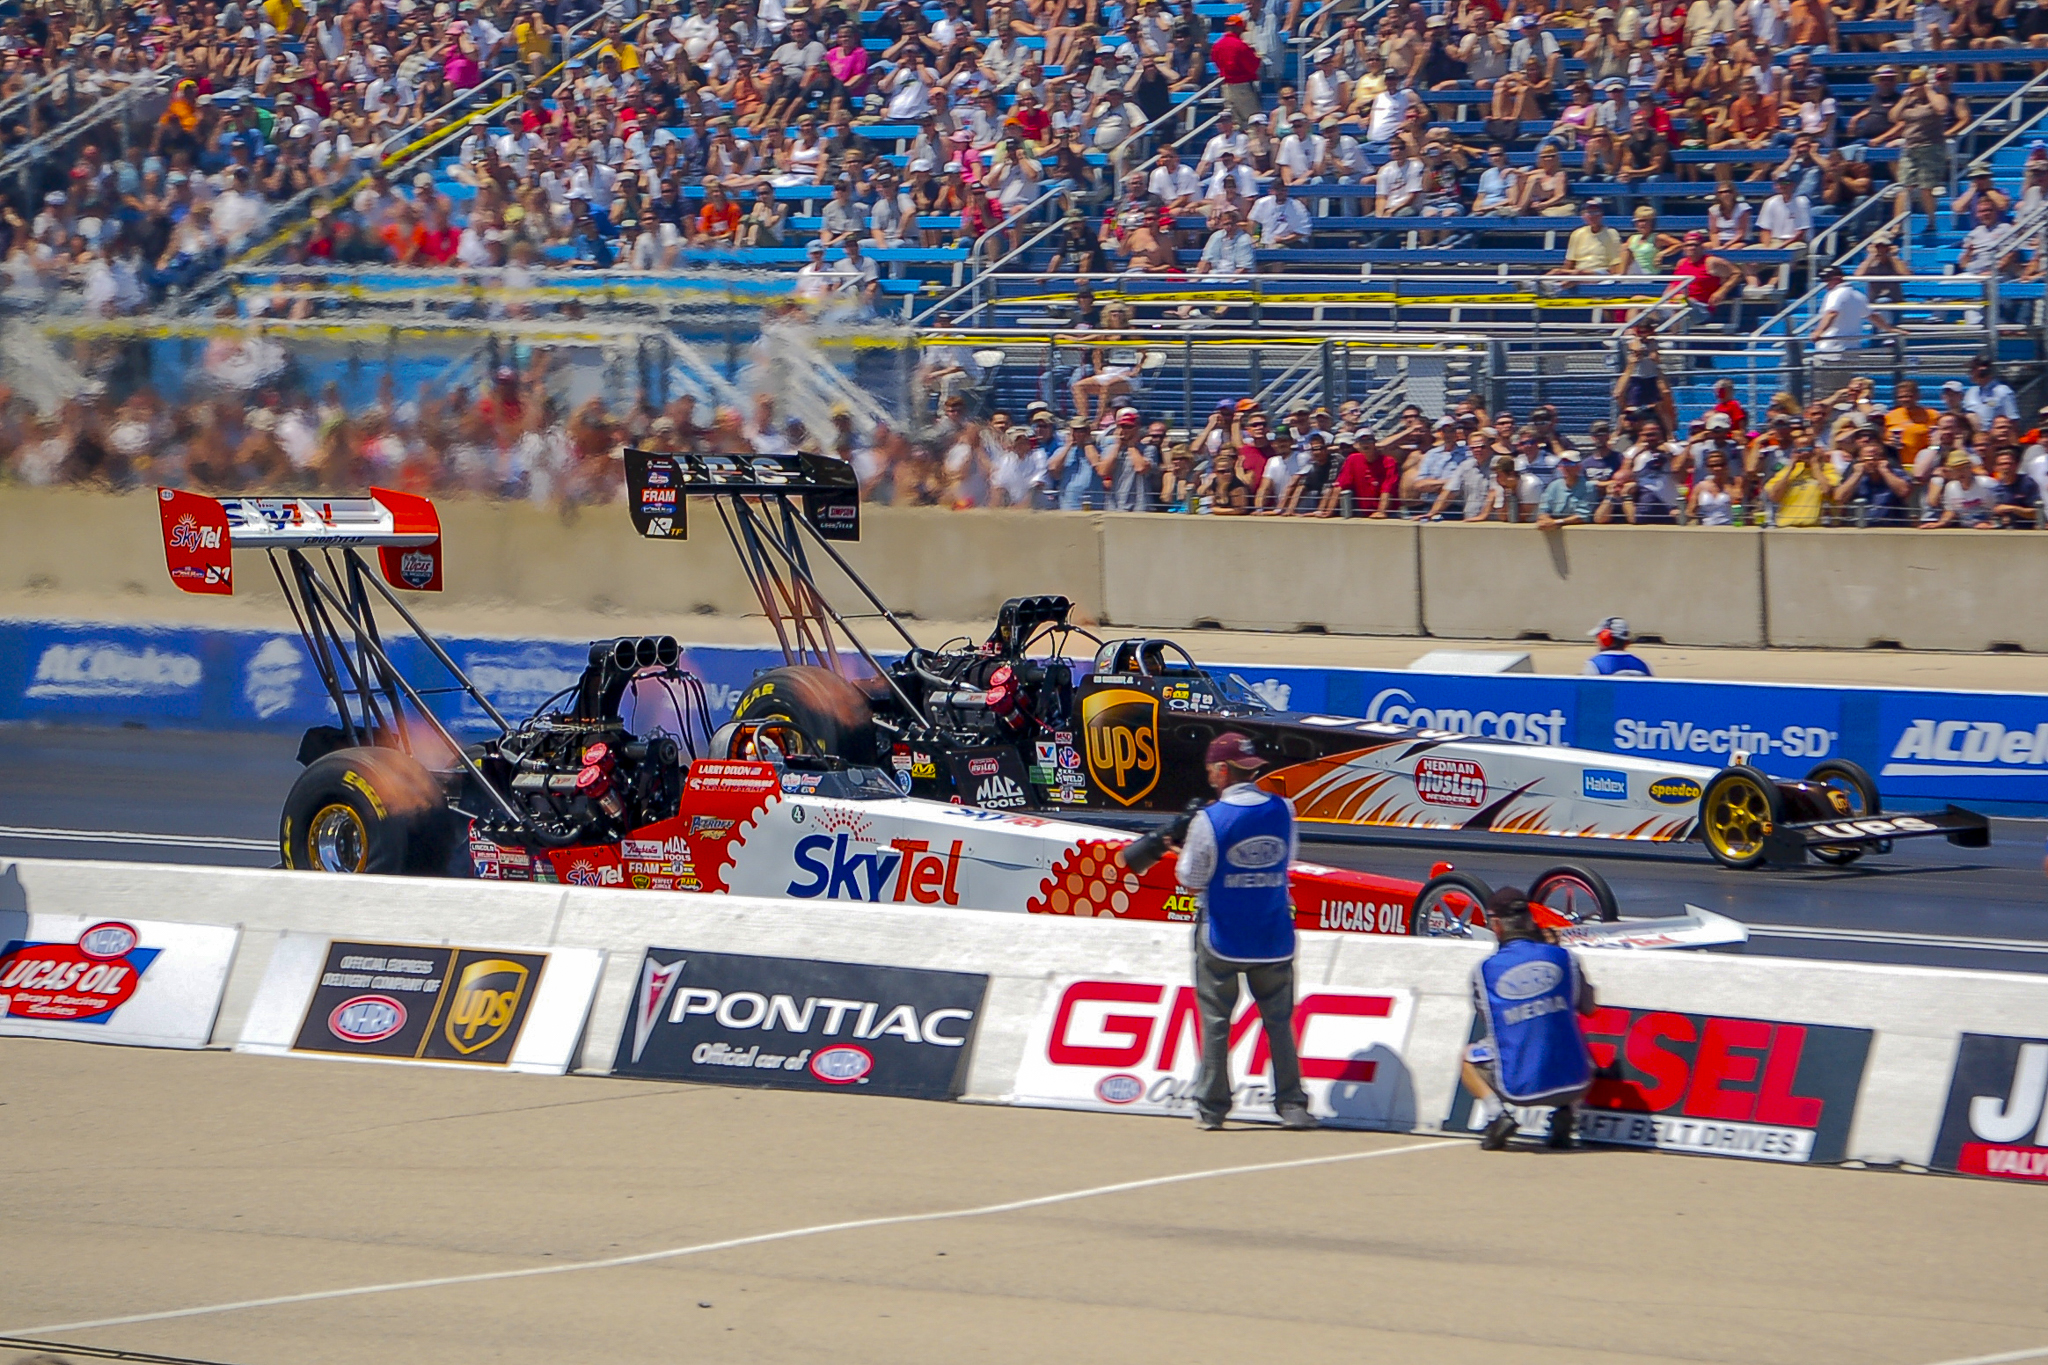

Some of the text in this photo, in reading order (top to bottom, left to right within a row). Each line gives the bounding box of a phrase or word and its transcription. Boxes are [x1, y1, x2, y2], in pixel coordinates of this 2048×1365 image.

[642, 490, 676, 502] FRAM
[169, 524, 222, 554] SkyTel
[303, 535, 365, 544] GOODYEAR
[1366, 688, 1567, 747] Comcast
[1891, 719, 2048, 765] ACDel
[1091, 726, 1155, 787] ups
[1423, 760, 1475, 774] HEDMAN
[698, 765, 751, 775] LARRY DIXON
[976, 775, 1024, 801] MAC
[1584, 776, 1625, 793] Haldex
[1651, 783, 1700, 798] speedco
[793, 806, 803, 822] 4
[977, 796, 1026, 809] TOOLS
[664, 835, 691, 854] MAC
[628, 862, 660, 874] FRAM
[664, 853, 692, 862] TOOLS
[785, 833, 963, 905] SkyTel
[566, 863, 624, 887] SkyTel
[1319, 899, 1375, 933] LUCAS
[1378, 903, 1406, 934] OIL
[386, 958, 434, 974] EXPRESS
[76, 964, 130, 995] OIL
[321, 972, 442, 993] DELIVERY COMPANY OF
[454, 989, 516, 1040] ups
[668, 987, 974, 1047] PONTIAC
[1047, 980, 1397, 1083] GMC
[691, 1042, 811, 1071] Official car of
[1577, 1006, 1824, 1128] ESEL
[1629, 1116, 1699, 1145] BELT
[1702, 1125, 1799, 1156] DRIVES
